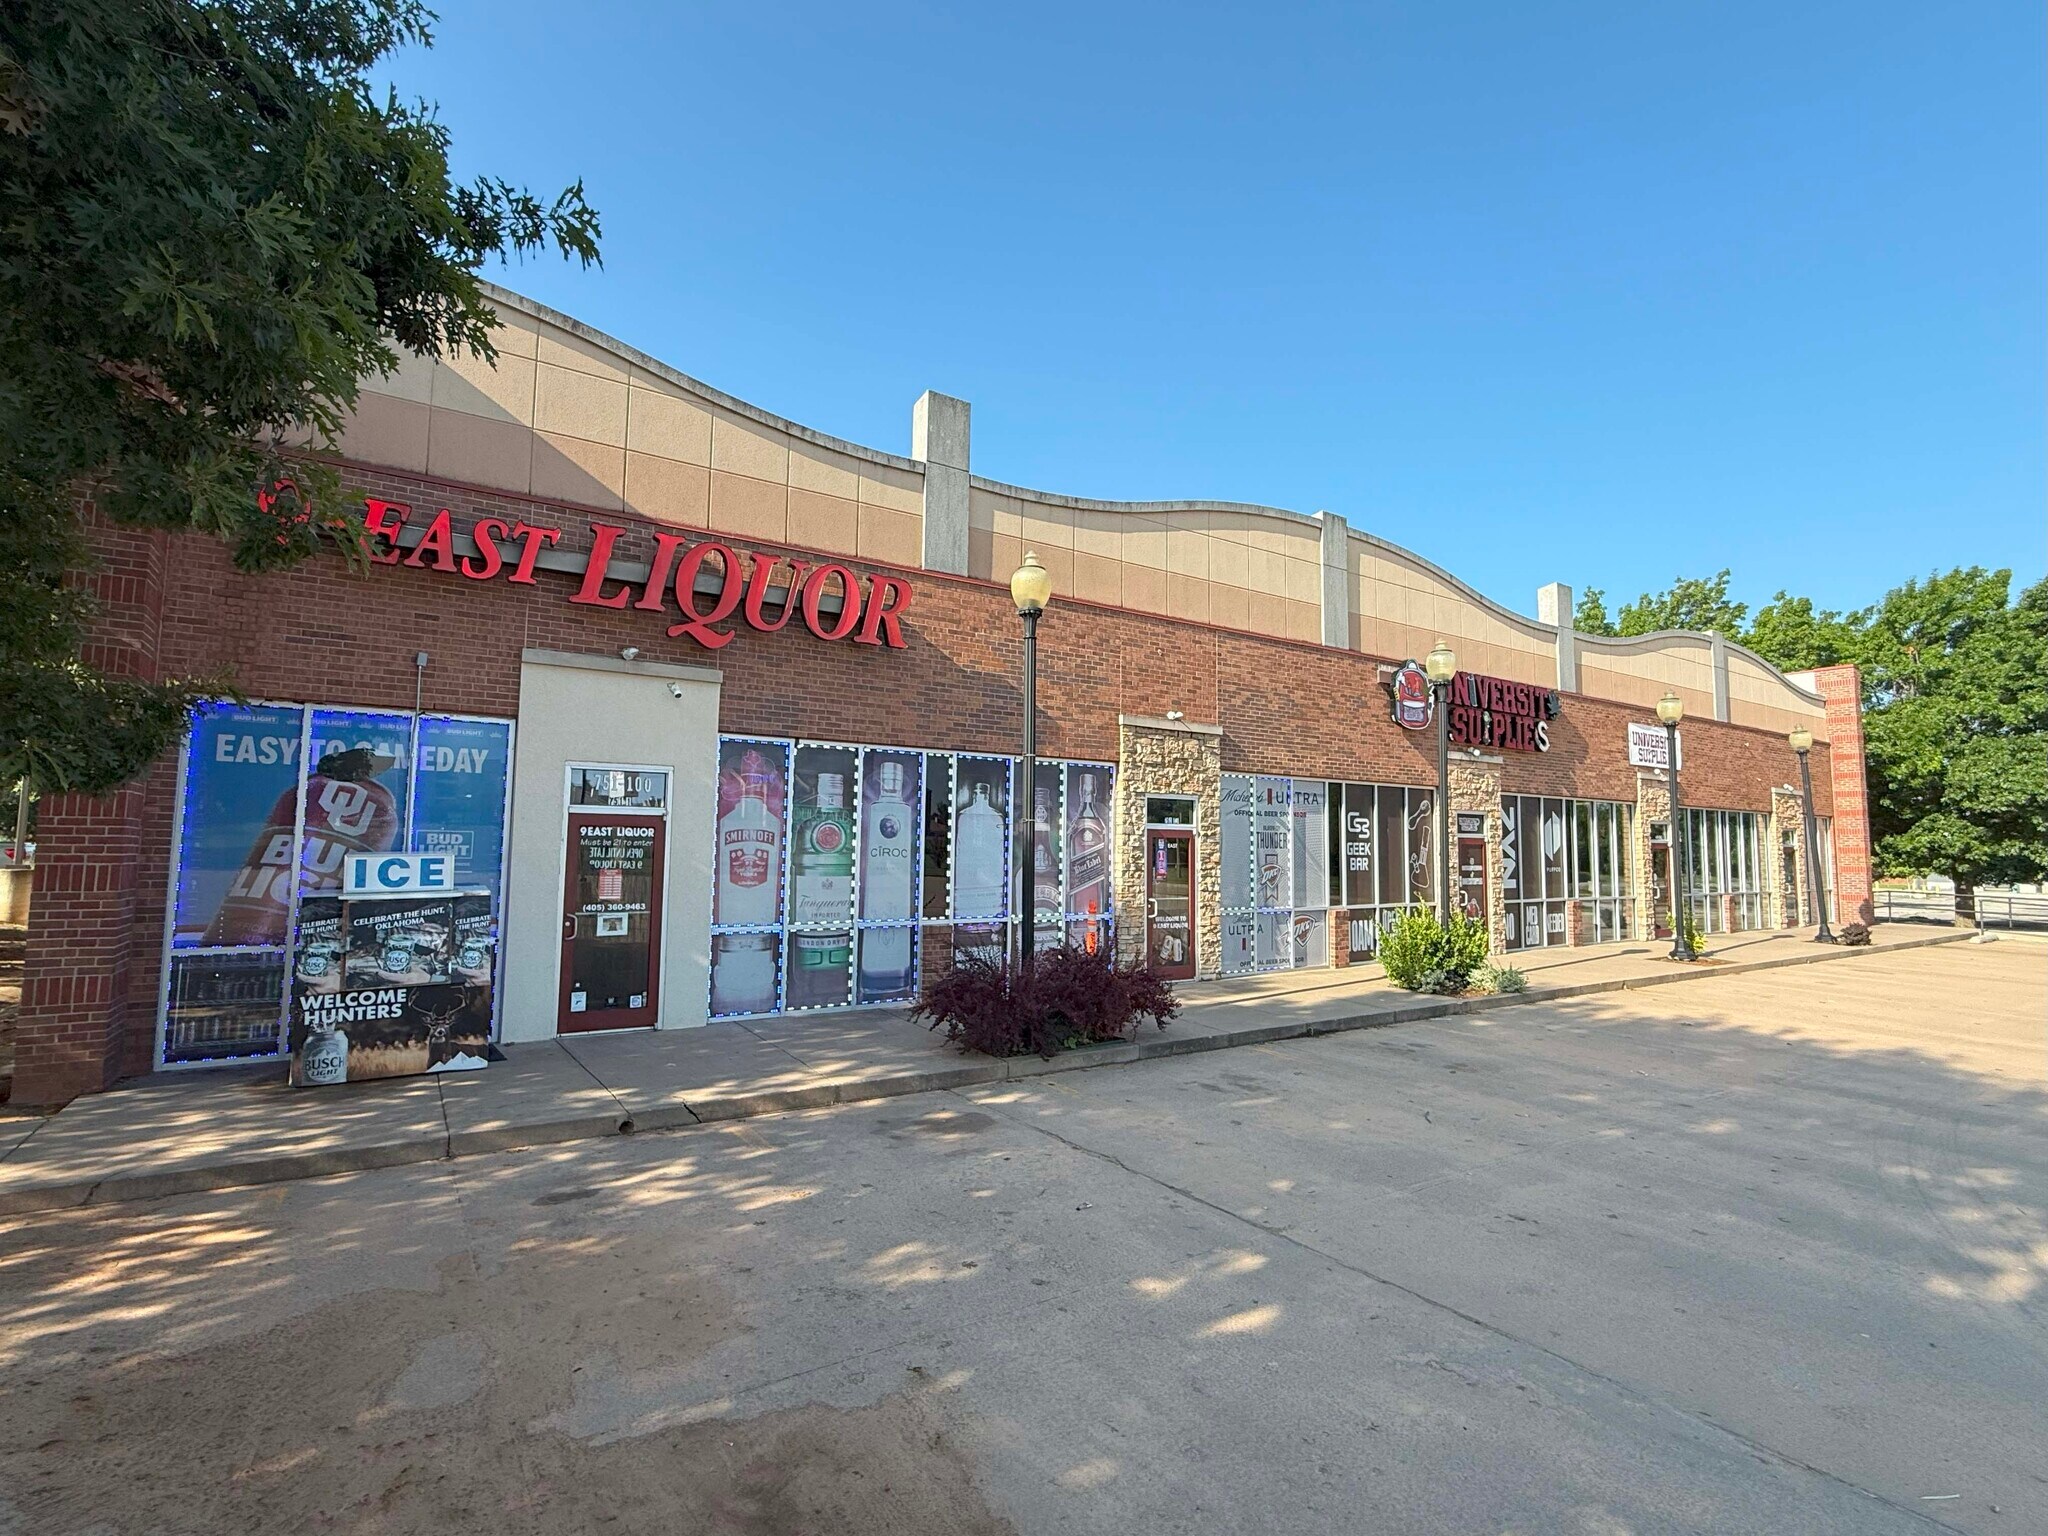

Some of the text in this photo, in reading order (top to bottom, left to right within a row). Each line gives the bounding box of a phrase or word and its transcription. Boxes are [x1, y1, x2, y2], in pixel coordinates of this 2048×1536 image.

[360, 497, 562, 585] EAST
[569, 524, 914, 649] LIQUOR
[1632, 731, 1667, 750] UNIVERSI
[216, 733, 300, 765] EASY
[354, 741, 489, 774] AMEDAY
[318, 780, 377, 837] OU
[426, 833, 463, 845] BUD
[616, 827, 655, 838] LIQUOR
[725, 830, 774, 844] SMIRNOFF
[580, 838, 601, 846] Must
[613, 838, 621, 846] 21
[1256, 832, 1287, 849] THUNDER
[260, 834, 348, 873] BU
[419, 845, 469, 856] LIGHT
[1347, 842, 1371, 856] GEEK
[1350, 858, 1369, 871] BAR
[354, 857, 445, 889] ICE
[583, 904, 605, 912] (405)
[353, 911, 402, 926] CELEBRATE
[404, 910, 420, 919] THE
[375, 917, 425, 930] OKLAHOMA
[455, 915, 491, 925] CELEBRATE
[472, 920, 490, 928] HUNT
[301, 924, 337, 936] THE HUNT
[300, 988, 407, 1011] WELCOME
[304, 1003, 403, 1026] HUNTERS
[311, 1068, 338, 1077] LIGHT
